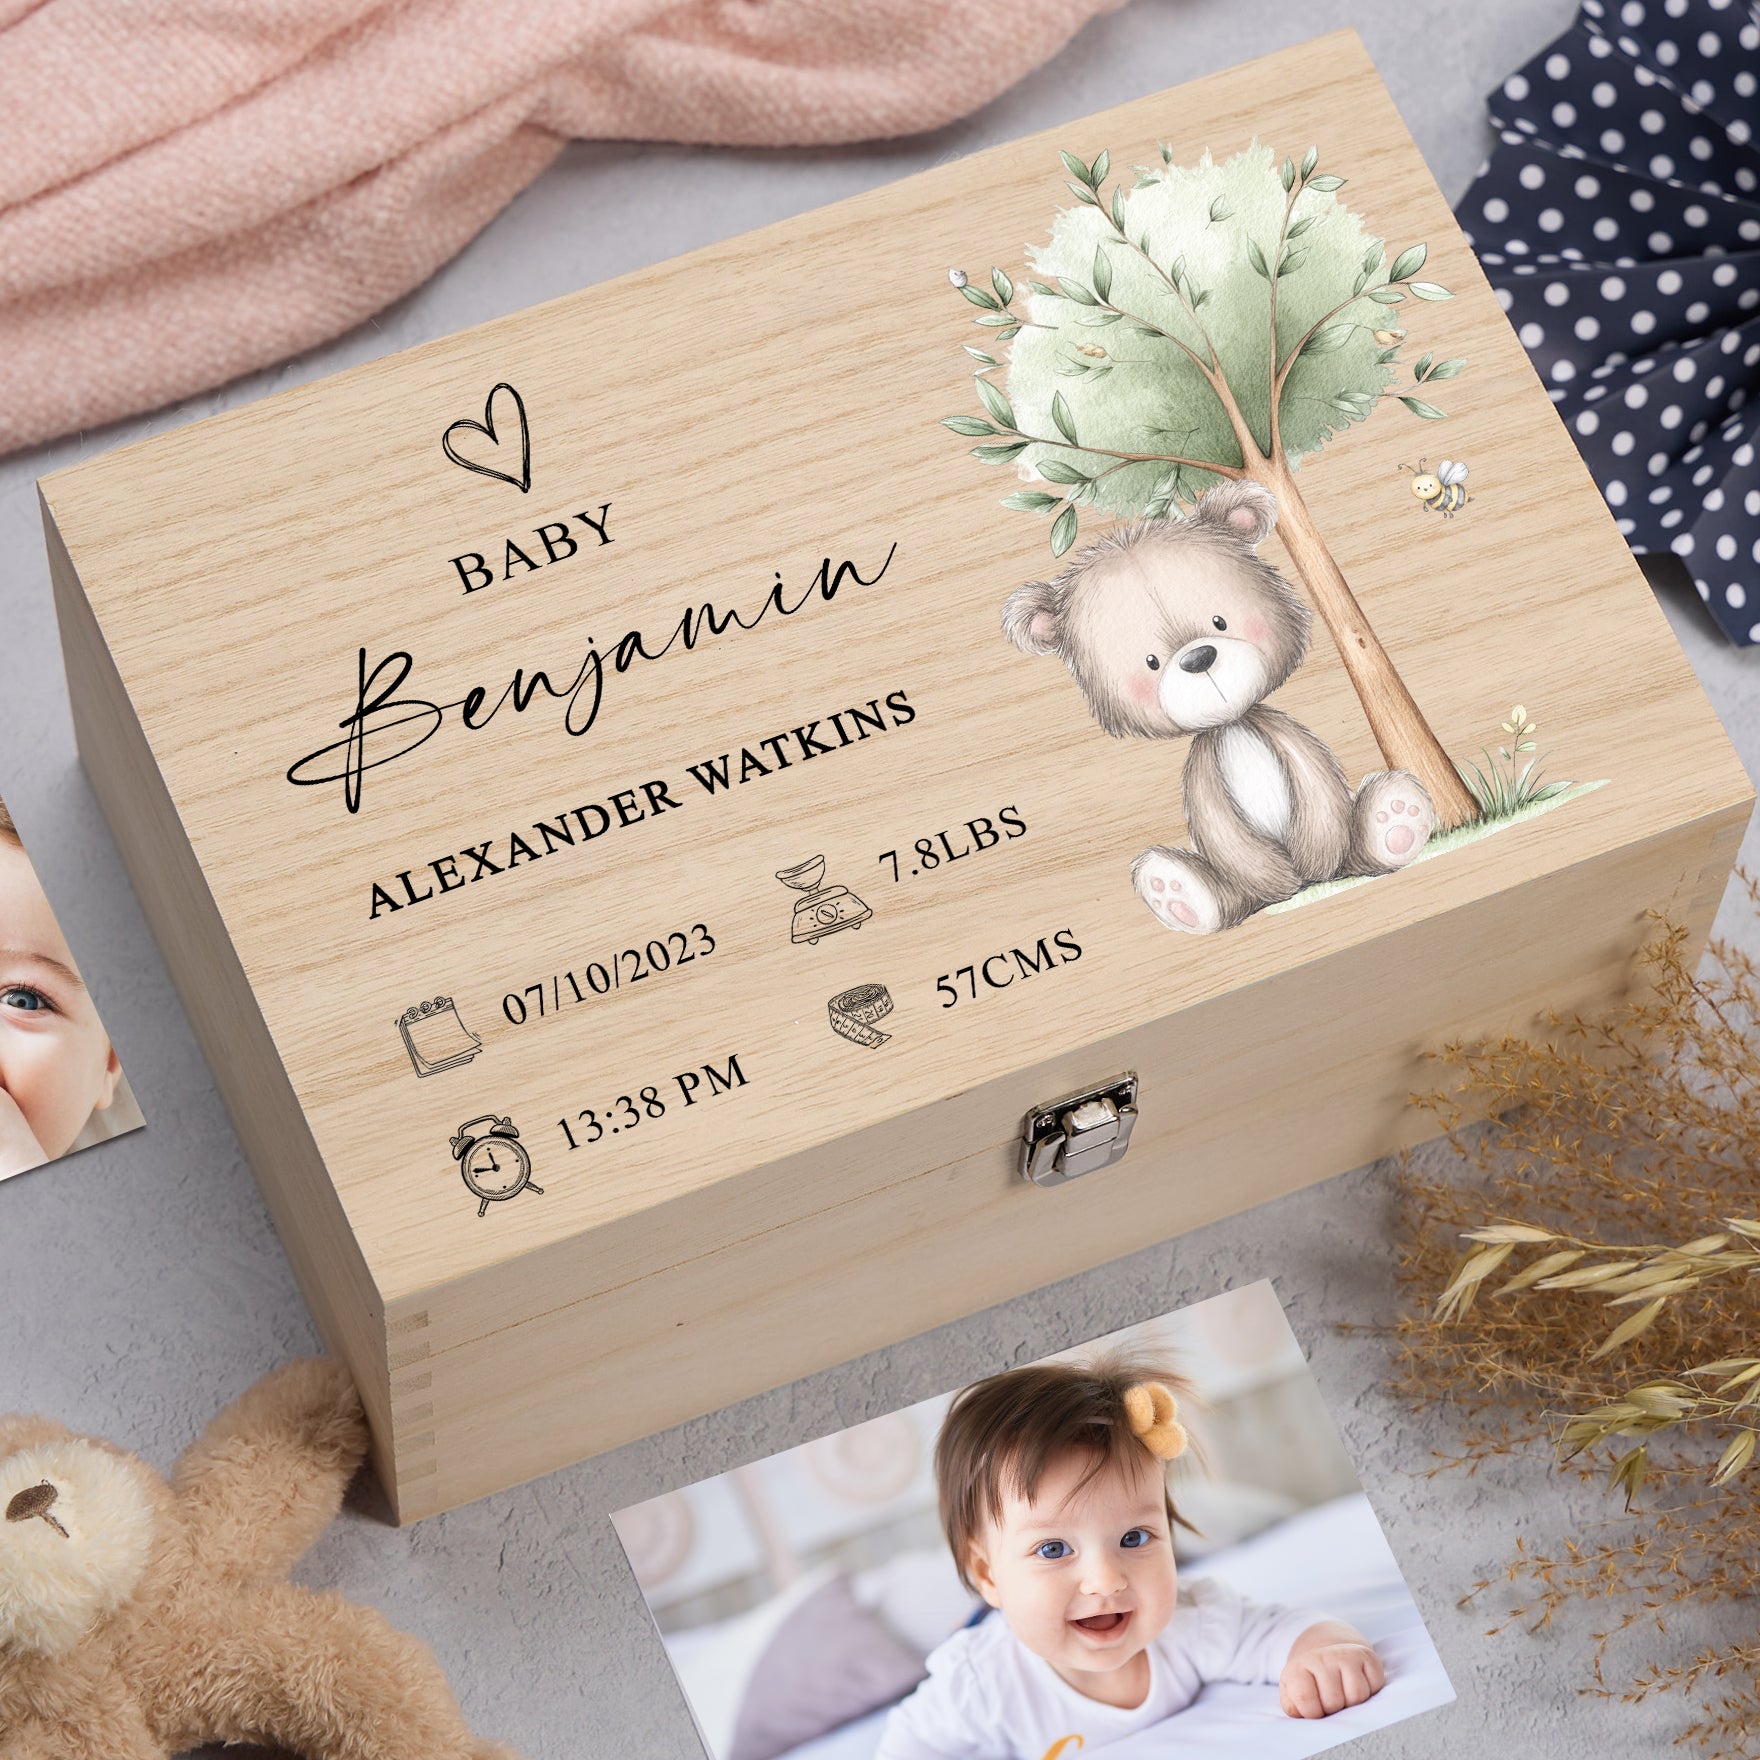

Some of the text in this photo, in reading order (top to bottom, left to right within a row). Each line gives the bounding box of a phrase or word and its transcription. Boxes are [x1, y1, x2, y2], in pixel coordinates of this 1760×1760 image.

[448, 502, 615, 596] BABY
[287, 541, 898, 814] Benjamin
[369, 689, 917, 920] ALEXANDER WATKINS
[879, 804, 1028, 883] 7.8LBS
[502, 923, 717, 1027] 07/10/2023
[936, 928, 1083, 1009] 57CMS
[557, 1054, 750, 1151] 13:38 PM
